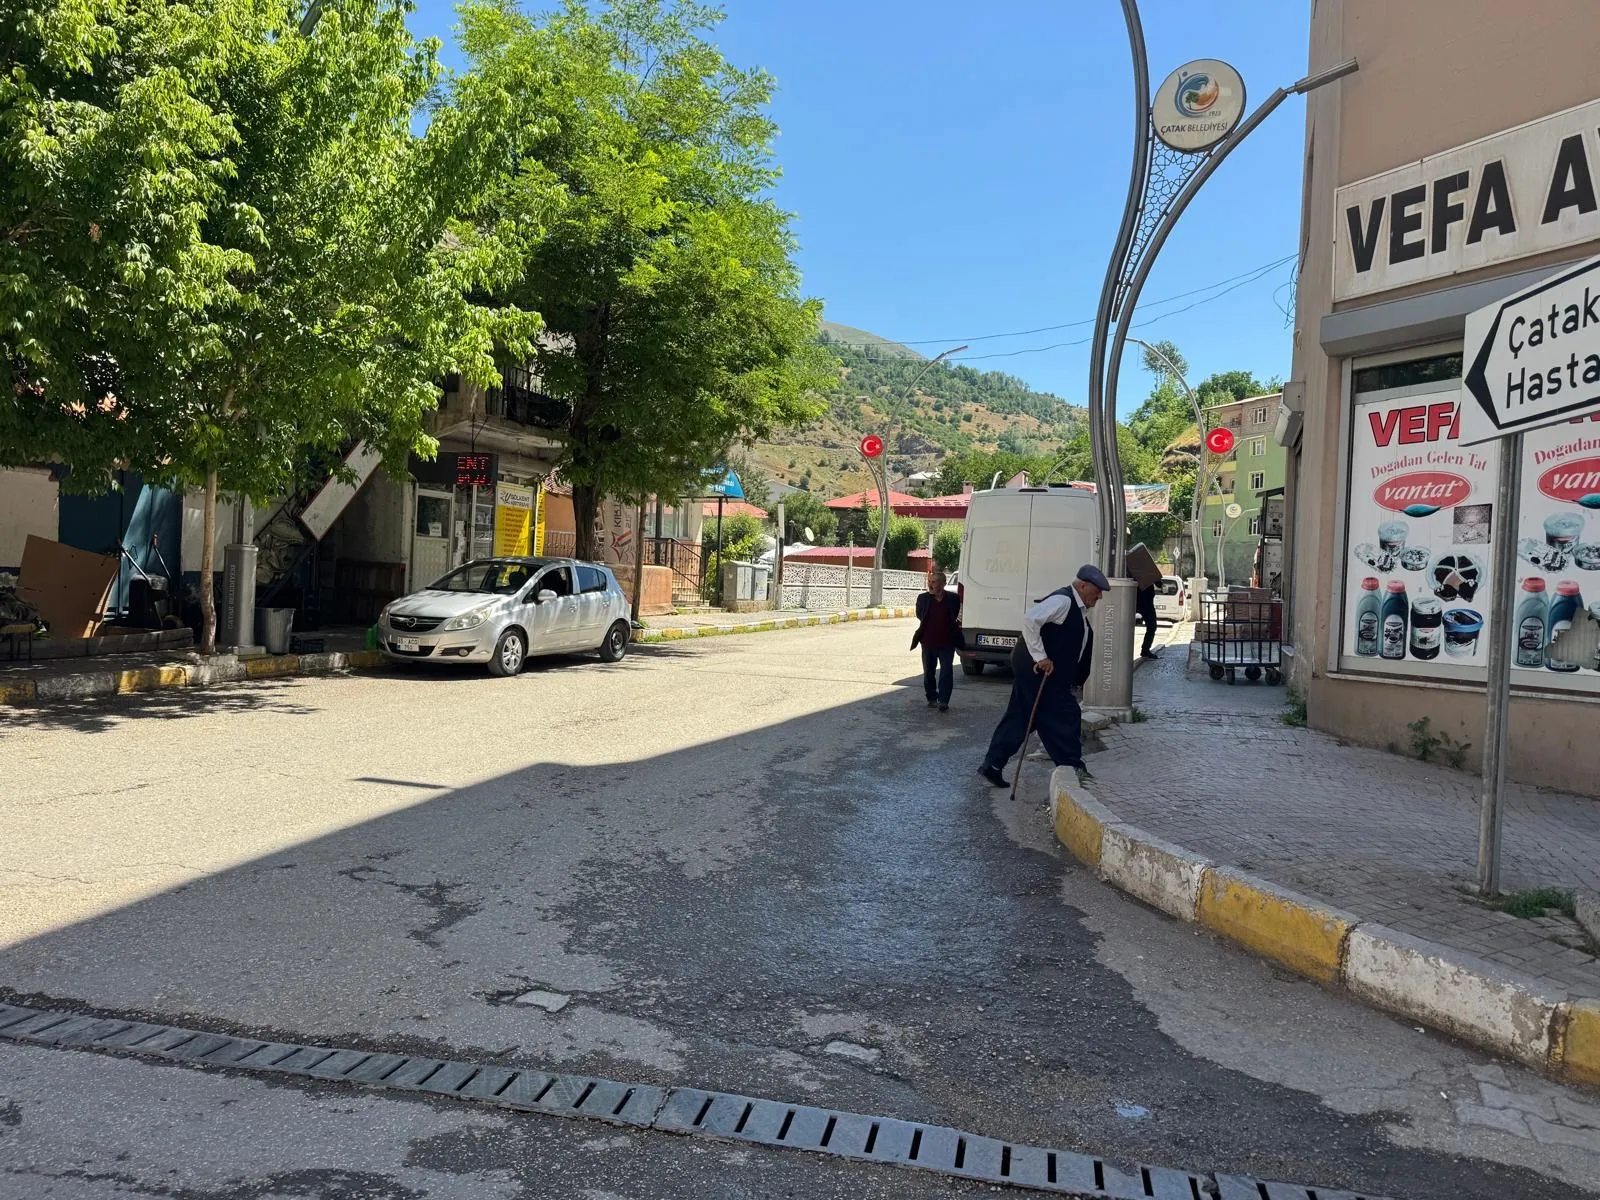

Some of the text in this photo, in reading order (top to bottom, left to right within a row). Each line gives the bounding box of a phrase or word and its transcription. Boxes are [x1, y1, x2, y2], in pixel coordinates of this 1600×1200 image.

[1160, 121, 1228, 136] ÇATAK BELEDİYESİ
[1346, 126, 1600, 274] VEFA A
[1508, 286, 1600, 360] Çatak
[1505, 352, 1600, 410] Hasta
[1426, 450, 1464, 466] Gelen
[1468, 452, 1488, 472] Tat
[1384, 480, 1459, 501] vantat
